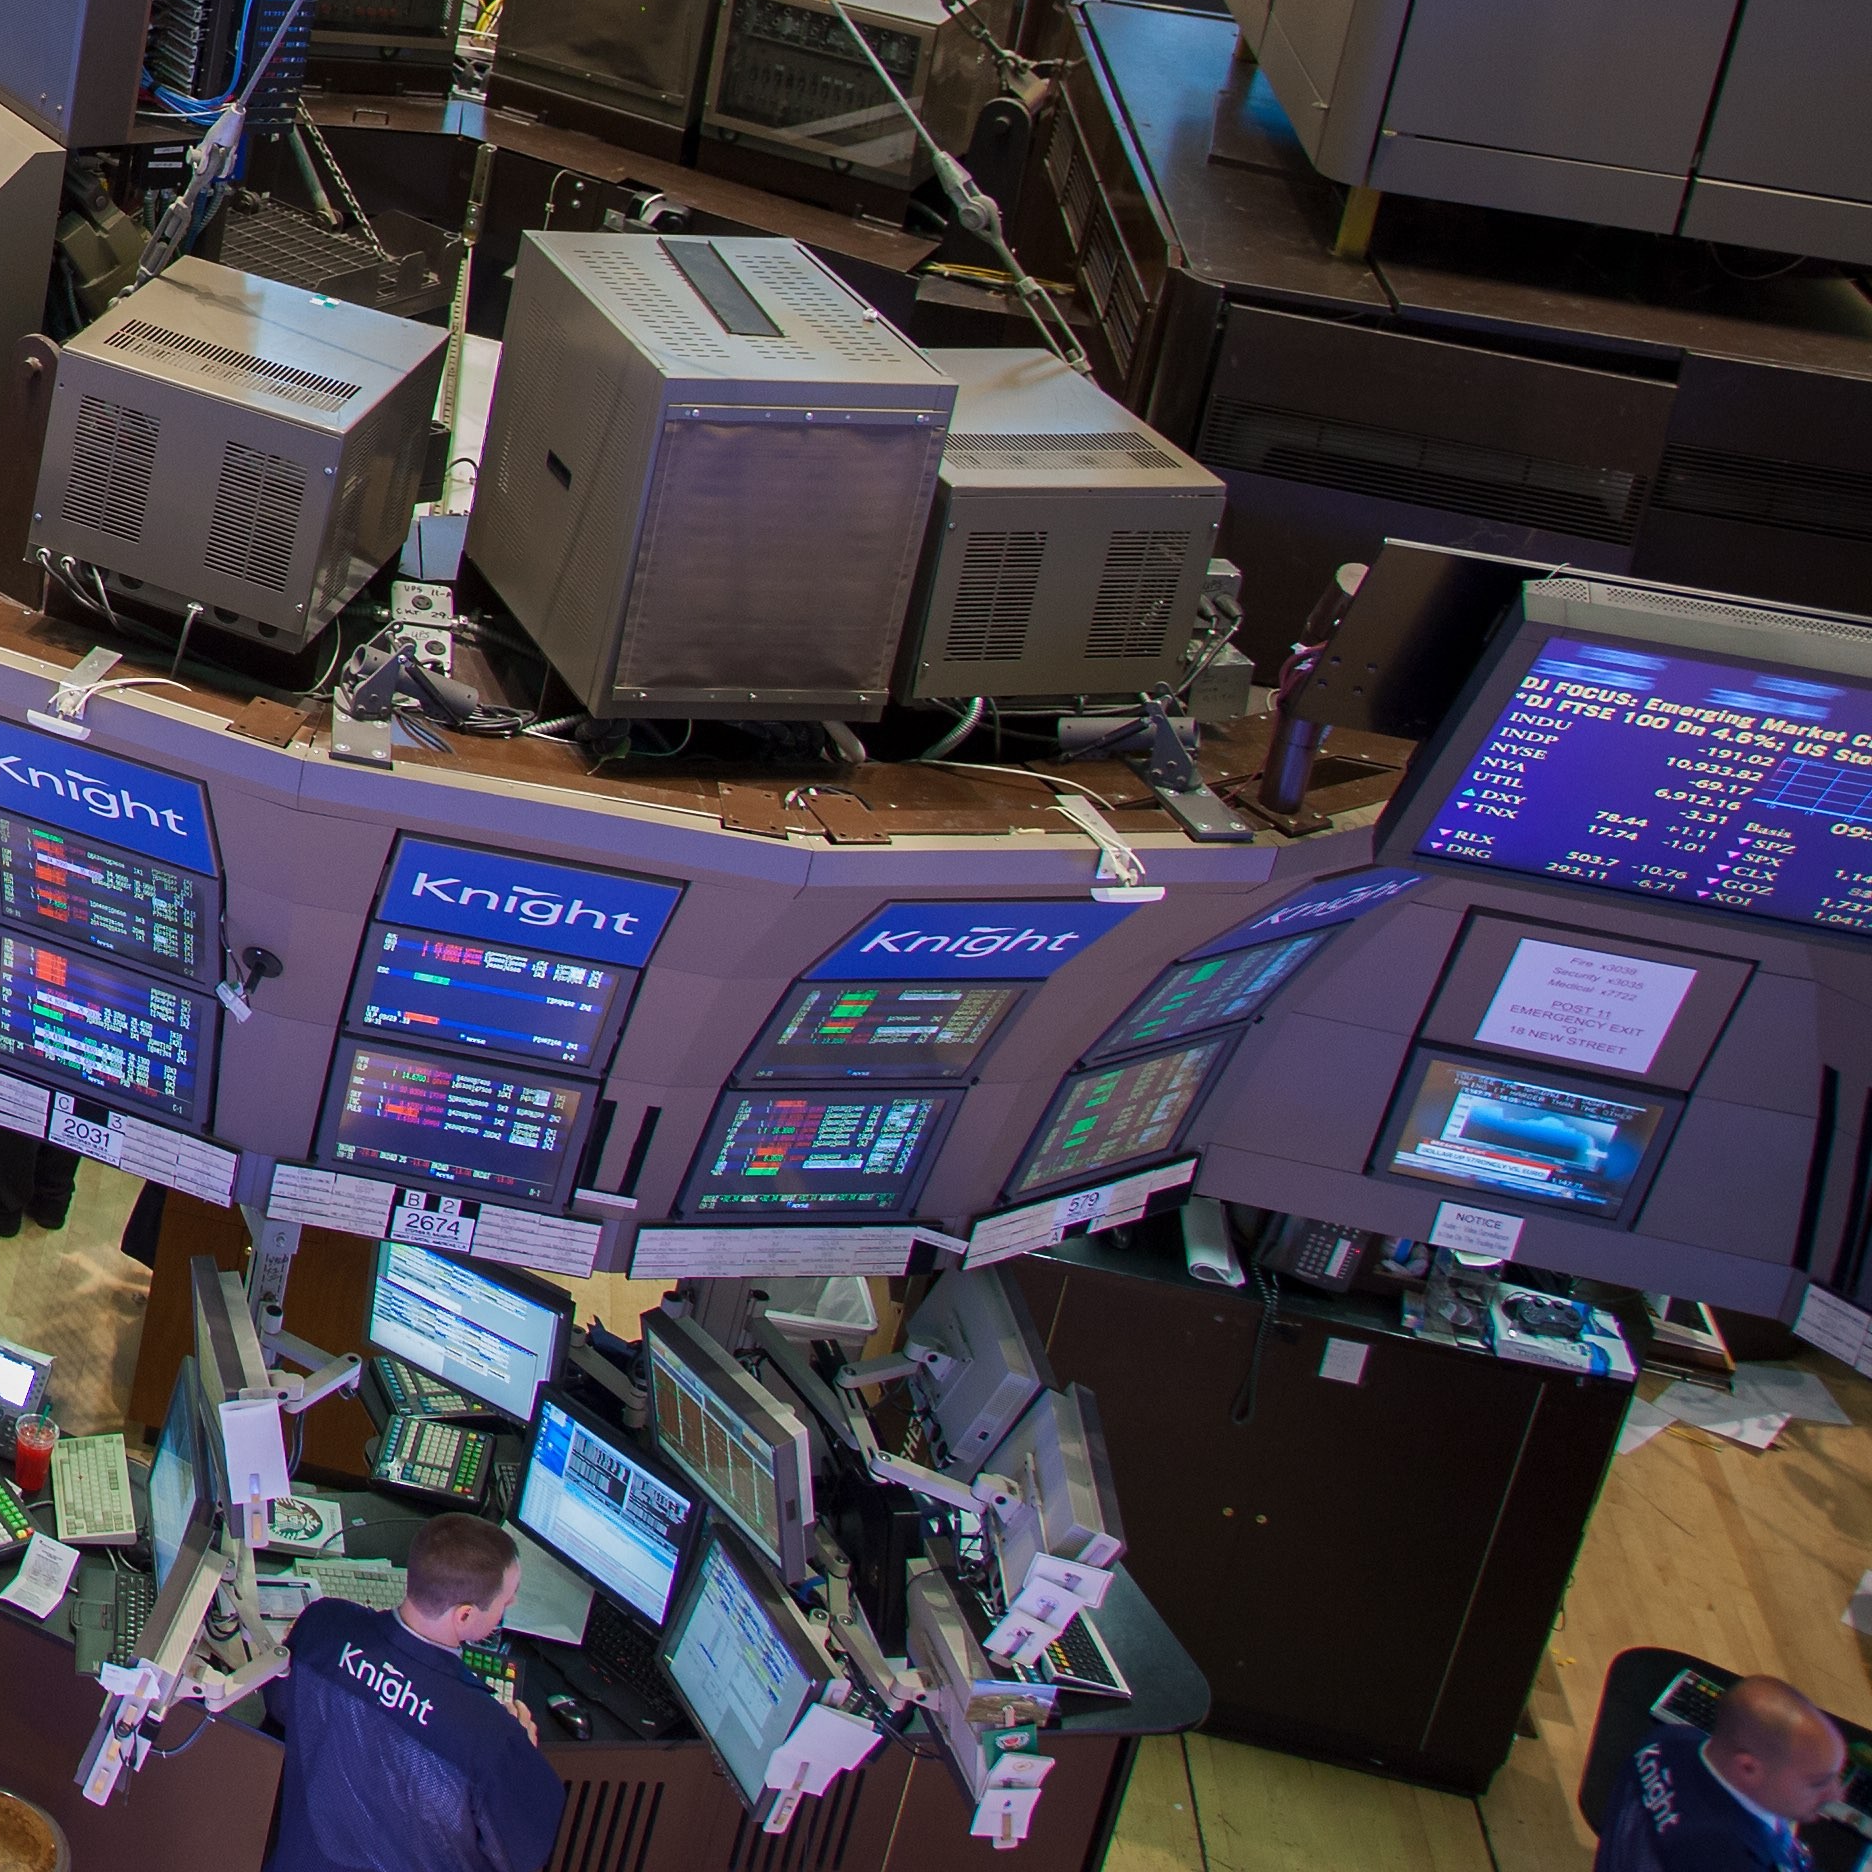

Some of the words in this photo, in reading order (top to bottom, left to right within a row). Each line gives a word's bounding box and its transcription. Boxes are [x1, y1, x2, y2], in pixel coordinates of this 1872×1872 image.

[1521, 676, 1543, 691] DJ
[1553, 682, 1638, 707] FOCUS:
[1644, 698, 1759, 731] Emerging
[1761, 718, 1848, 743] Market
[1557, 701, 1617, 721] FTSE
[1624, 712, 1670, 730] 100
[1674, 720, 1708, 737] Dn
[1711, 727, 1786, 754] 4.6%;
[1792, 741, 1829, 758] US
[1499, 726, 1560, 745] INDP
[1666, 755, 1765, 783] 10,933.82
[1509, 711, 1574, 731] INDU
[1698, 747, 1776, 768] -191.02
[1480, 757, 1527, 776] NYA
[1654, 787, 1742, 813] 6,912.16
[1488, 740, 1548, 762] NYSE
[1688, 778, 1755, 796] -69.17
[1471, 770, 1525, 790] UTIL
[1679, 809, 1729, 826] -3.31
[1479, 788, 1528, 807] DXY
[1594, 810, 1649, 829] 78.44
[1471, 802, 1520, 821] TNX
[1587, 824, 1640, 842] 17.74
[1445, 842, 1494, 861] DRG
[1544, 862, 1610, 882] 293.11
[1453, 829, 1497, 847] RLX
[1565, 850, 1620, 868] 503.7
[1631, 863, 1690, 881] -10.76
[411, 869, 642, 937] Knight
[858, 924, 1082, 959] Knight
[1552, 966, 1601, 984] Security
[1570, 957, 1594, 968] Fire
[1548, 978, 1595, 994] Medical
[1600, 987, 1638, 1003] x7722
[1552, 1000, 1593, 1016] POST
[1597, 1009, 1612, 1020] 11
[1510, 1003, 1607, 1030] EMERGENCY
[1609, 1023, 1645, 1038] EXIT
[1510, 1025, 1526, 1036] 18
[1528, 1028, 1564, 1043] NEW
[1566, 1035, 1628, 1057] STREET
[58, 1095, 72, 1110] C
[111, 1115, 124, 1129] 3
[62, 1116, 113, 1149] 2031
[408, 1192, 422, 1208] B
[443, 1199, 456, 1215] 2
[1068, 1192, 1100, 1213] 579
[1456, 1212, 1504, 1231] NOTICE
[404, 1211, 462, 1237] 2674
[337, 1641, 436, 1726] Knight
[1632, 1743, 1681, 1834] Knight
